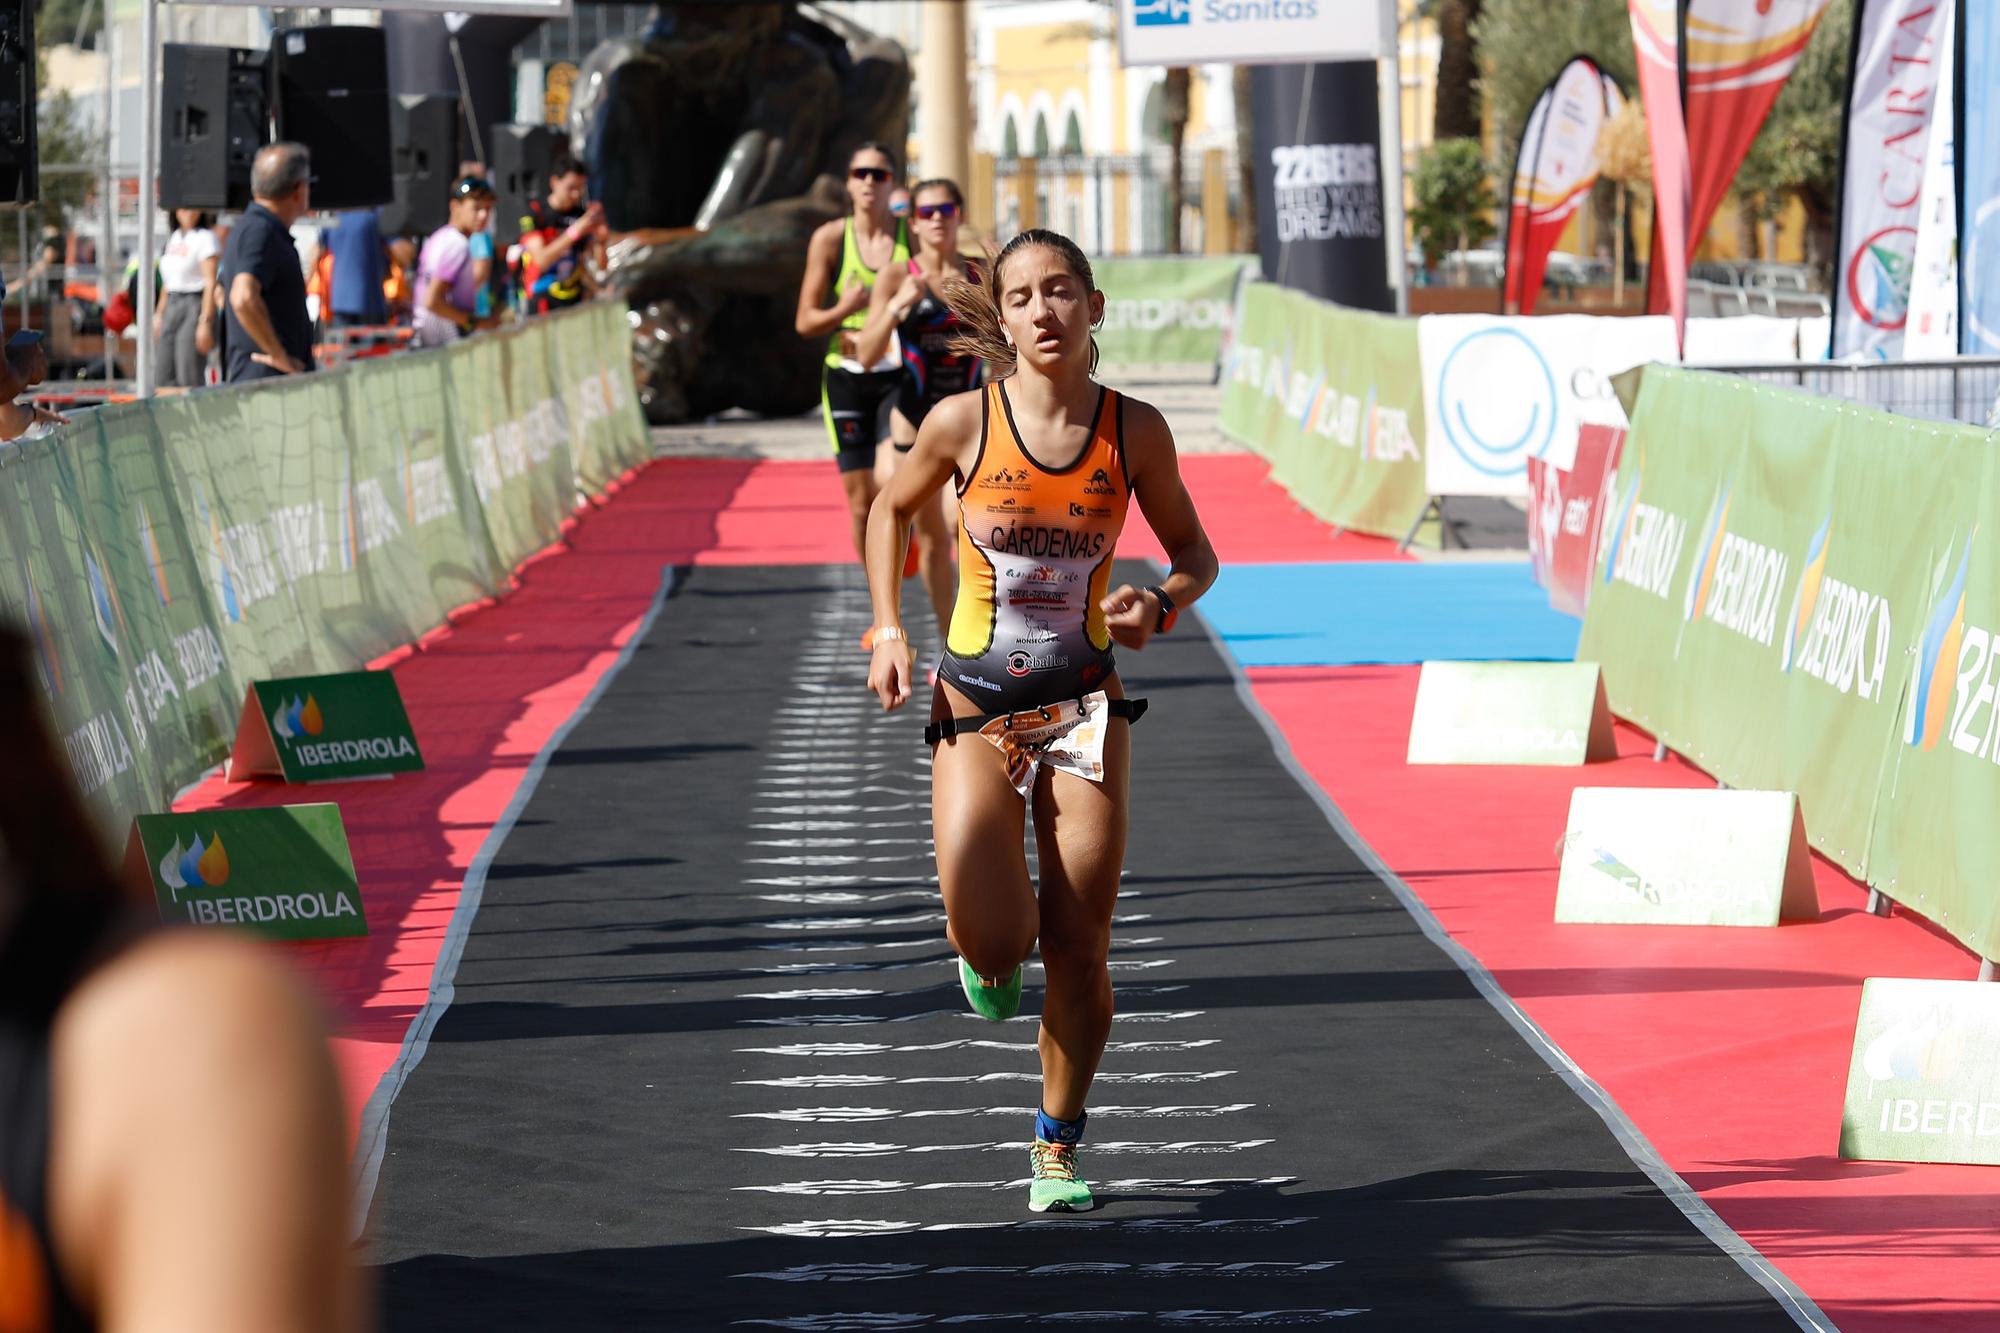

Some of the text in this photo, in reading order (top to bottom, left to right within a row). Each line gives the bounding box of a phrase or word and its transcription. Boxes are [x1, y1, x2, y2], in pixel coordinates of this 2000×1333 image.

[1205, 0, 1319, 23] Sanitas
[1271, 144, 1377, 188] 226ERS
[1276, 206, 1382, 242] DREAMS
[991, 519, 1105, 559] CÁRDENAS
[295, 736, 415, 766] IBERDROLA
[186, 892, 357, 925] IBERDROLA
